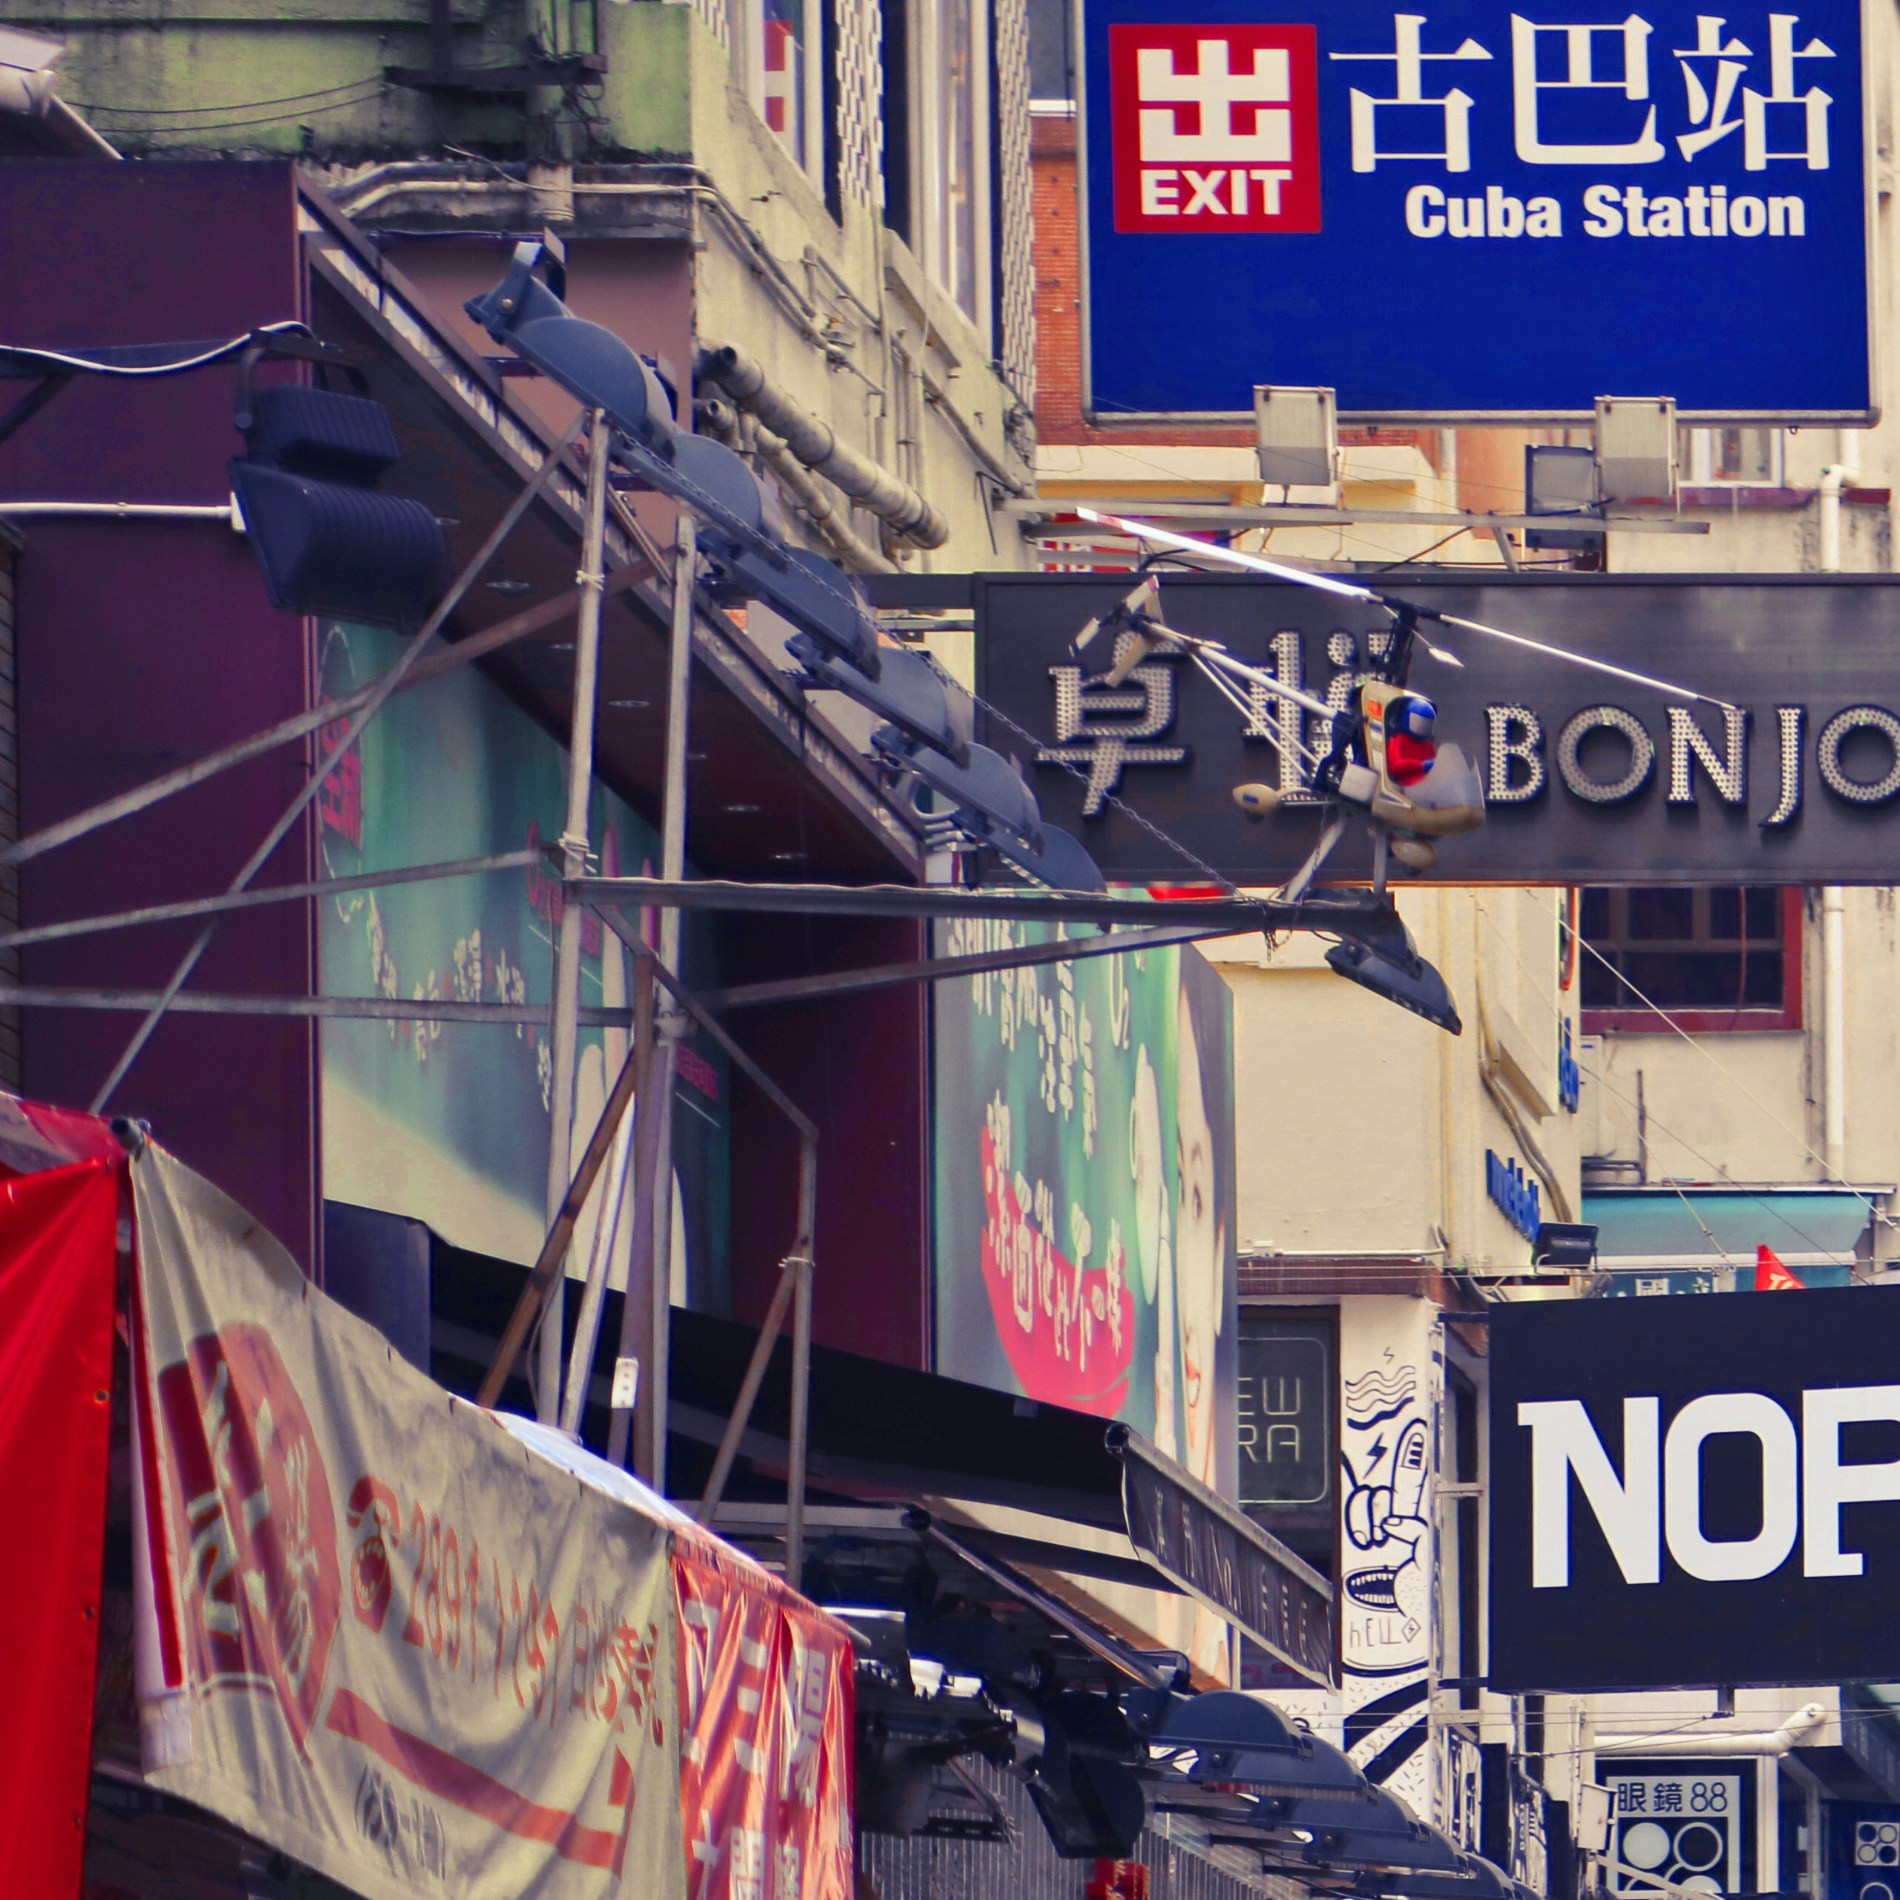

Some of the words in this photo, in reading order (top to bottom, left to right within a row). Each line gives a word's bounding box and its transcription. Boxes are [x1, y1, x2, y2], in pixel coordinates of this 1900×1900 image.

[1138, 39, 1293, 163] 出
[1328, 12, 1838, 174] 古巴站
[1138, 169, 1293, 217] EXIT
[1404, 184, 1563, 239] Cuba
[1582, 184, 1807, 239] Station
[1617, 1781, 1728, 1813] 眼鏡88
